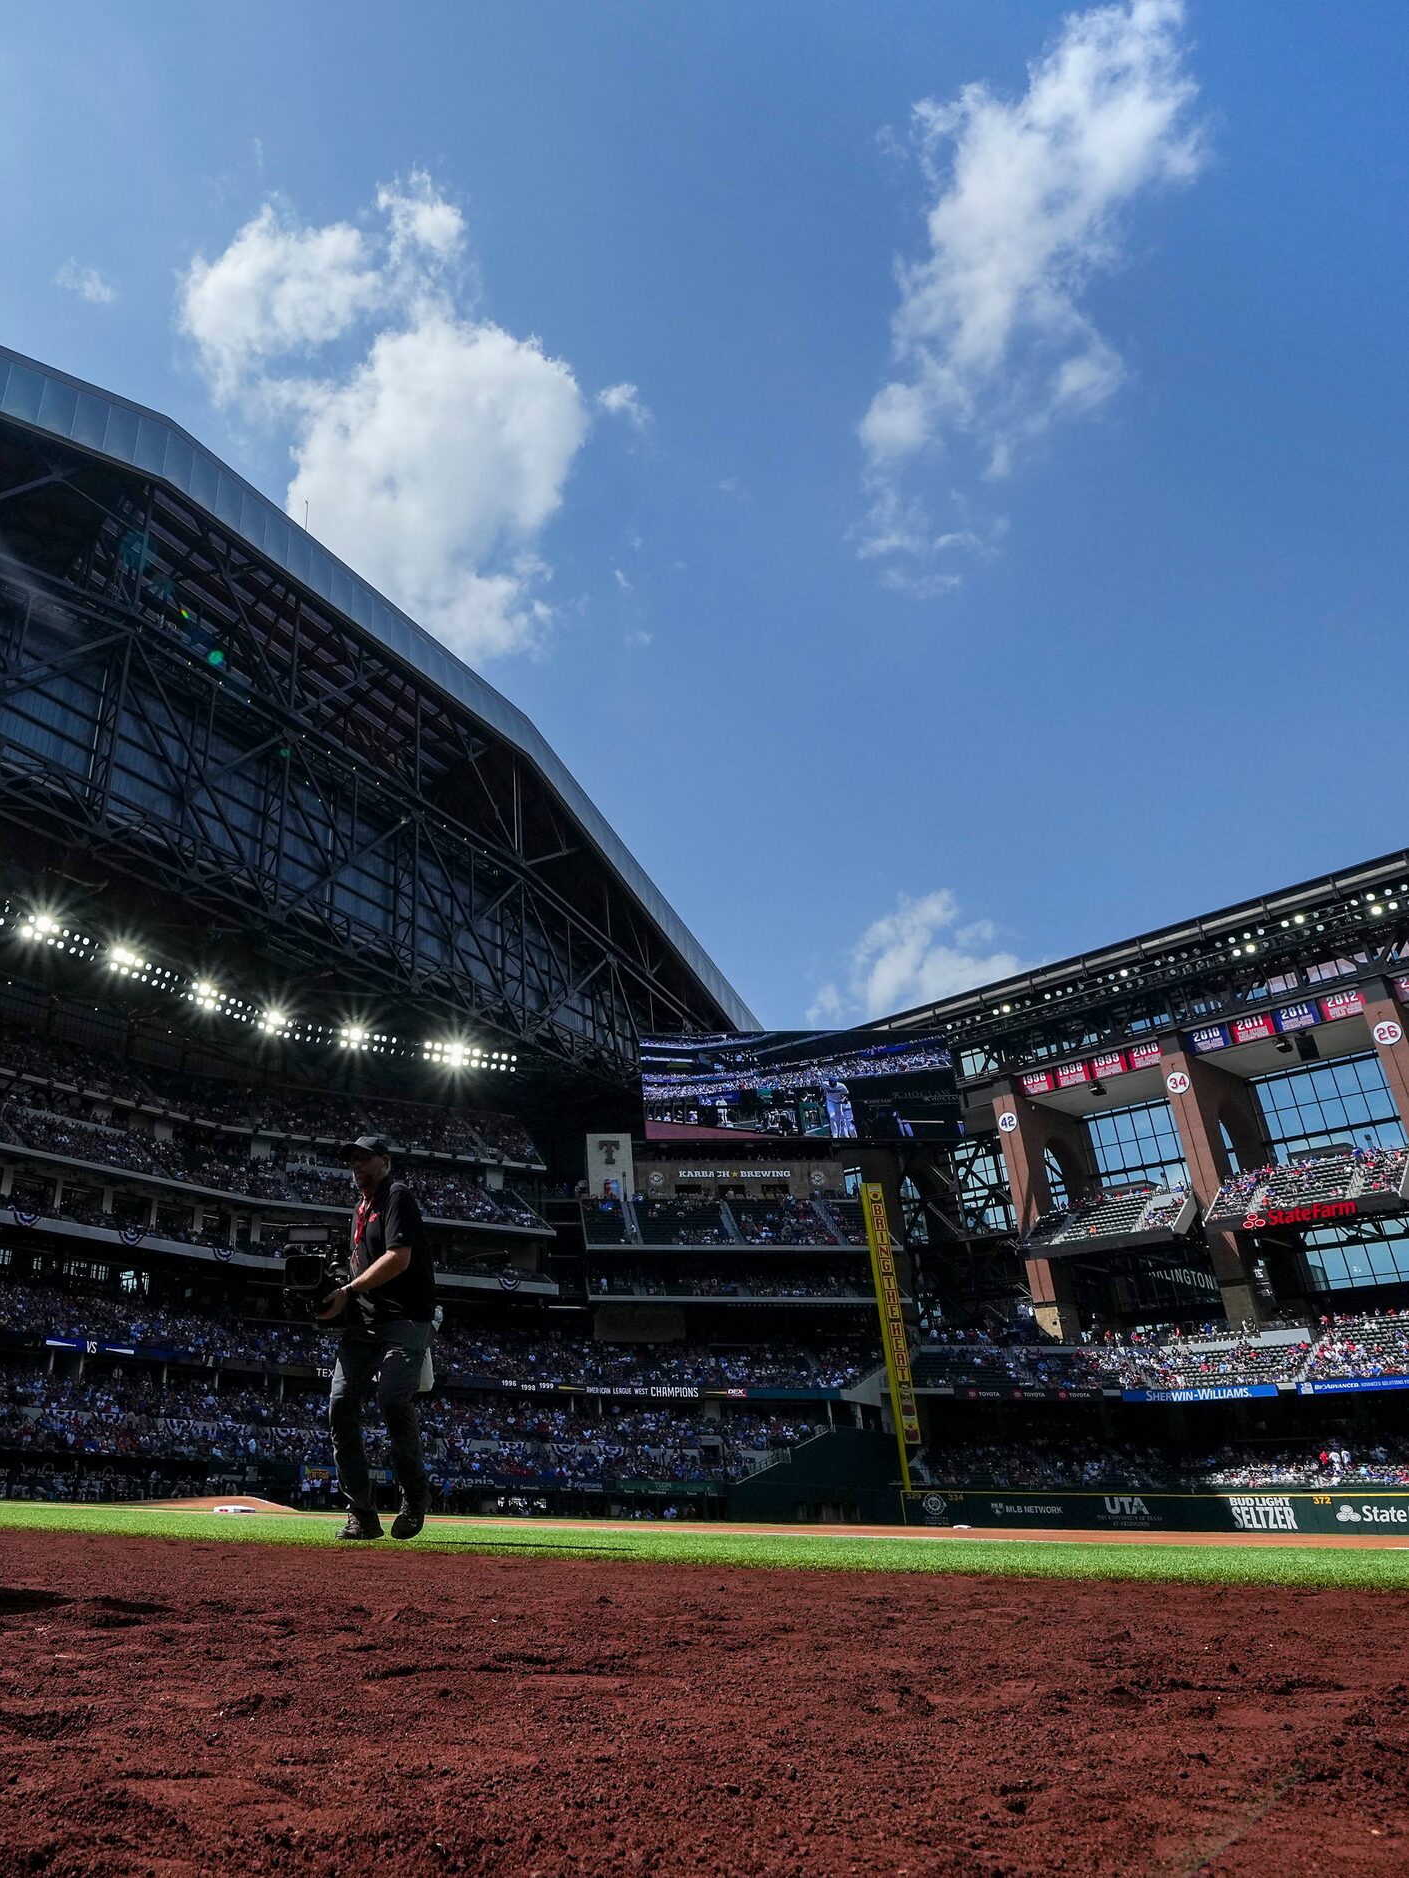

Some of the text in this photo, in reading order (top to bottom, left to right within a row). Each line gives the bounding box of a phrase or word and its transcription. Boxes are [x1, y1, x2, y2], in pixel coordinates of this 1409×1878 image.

[1326, 990, 1359, 1008] 2012
[1279, 1003, 1309, 1021] 2011
[1236, 1014, 1264, 1032] 2011
[1192, 1026, 1220, 1043] 2010
[1376, 1025, 1398, 1040] 26
[1132, 1042, 1159, 1058] 2010
[1022, 1071, 1047, 1086] 1996
[1169, 1075, 1188, 1089] 34
[1000, 1115, 1015, 1128] 42
[598, 1140, 620, 1164] T
[740, 1170, 791, 1178] BREWING
[86, 1341, 98, 1354] VS
[586, 1386, 699, 1398] AMERICAN LEAGUE WEST CHAMPIONS
[1104, 1496, 1150, 1515] UTA
[1229, 1497, 1291, 1506] BUD LIGHT
[1312, 1496, 1332, 1505] 372
[1005, 1505, 1064, 1514] MLB NETWORK
[1362, 1505, 1409, 1522] State
[1231, 1506, 1299, 1530] SELTZER
